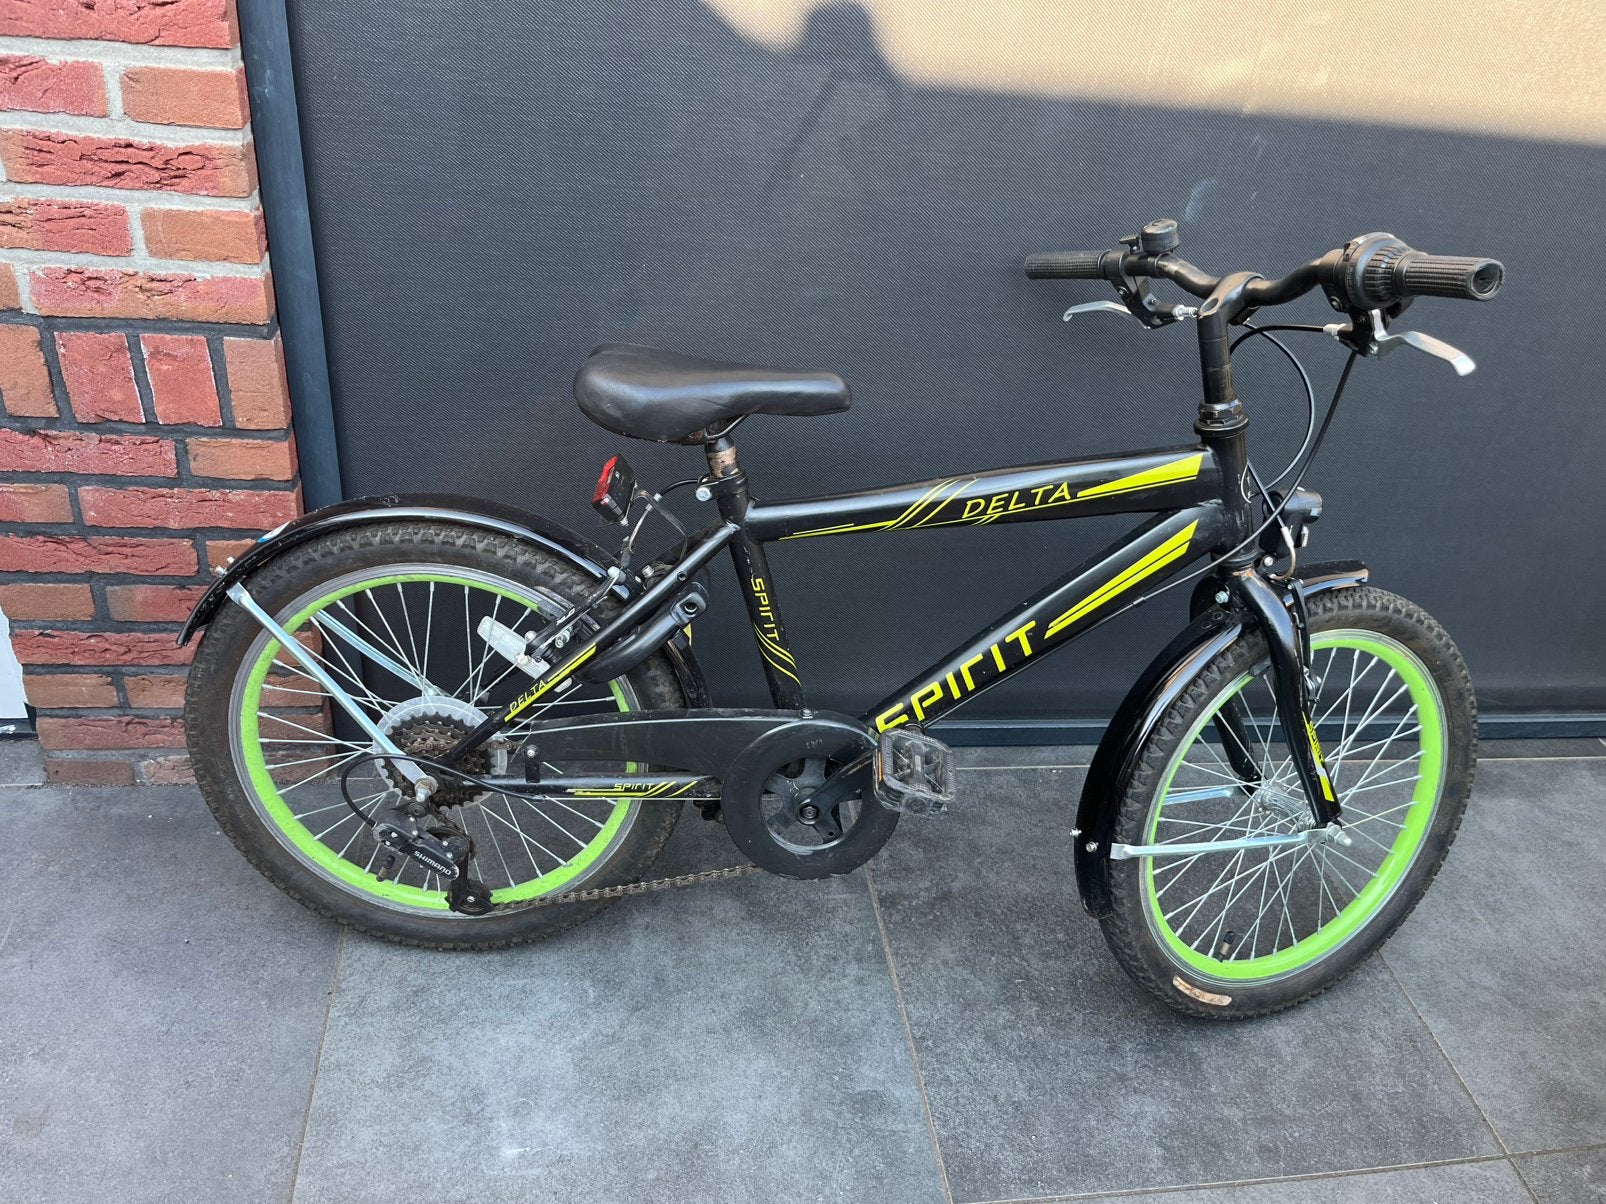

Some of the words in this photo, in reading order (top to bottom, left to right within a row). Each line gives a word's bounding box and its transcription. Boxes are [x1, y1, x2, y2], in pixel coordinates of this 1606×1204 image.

[962, 482, 1071, 519] DELTA
[751, 578, 780, 641] SPIRIT
[875, 620, 1037, 734] SPIRIT
[510, 679, 547, 713] DELTA
[613, 782, 655, 792] SPIRIT
[413, 850, 452, 876] SHIMANO
